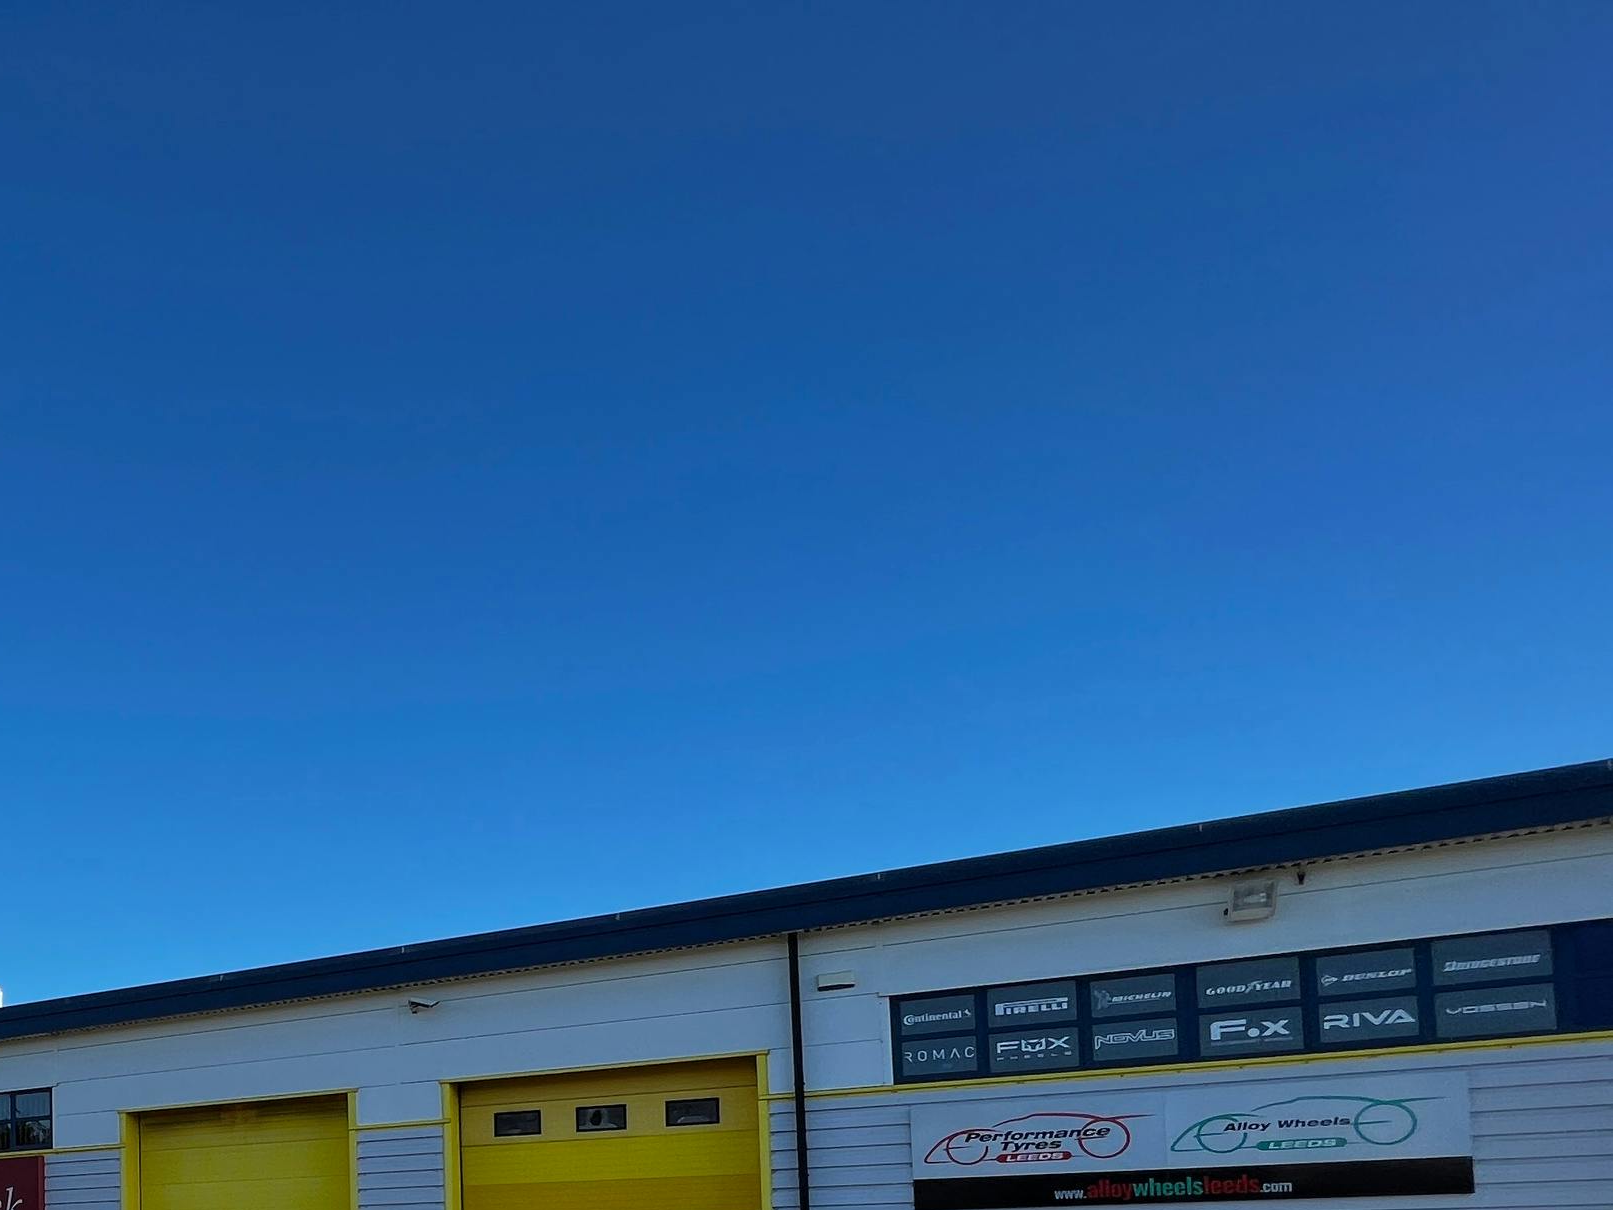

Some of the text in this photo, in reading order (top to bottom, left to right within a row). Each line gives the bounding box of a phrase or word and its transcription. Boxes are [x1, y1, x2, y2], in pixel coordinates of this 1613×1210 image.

[1443, 954, 1541, 972] BRIDGESTONE
[1342, 968, 1412, 982] DUNLOP
[1205, 979, 1292, 996] GOODYEAR
[1111, 990, 1172, 1004] MICHELIN
[994, 996, 1069, 1016] PIRELLI
[1445, 1000, 1547, 1015] VOSSEN
[903, 1010, 963, 1026] Continental
[1323, 1008, 1416, 1030] RIVA
[996, 1036, 1070, 1054] FOX
[1094, 1028, 1175, 1050] NOVUS
[904, 1046, 975, 1063] ROMAC
[1223, 1117, 1351, 1133] Alloy Wheels
[965, 1126, 1110, 1143] Performance
[1001, 1140, 1062, 1153] Tyres
[1268, 1138, 1337, 1150] LEEDS
[1005, 1152, 1064, 1162] LEEDS
[1054, 1174, 1293, 1200] www.alloywheelsleeds.com
